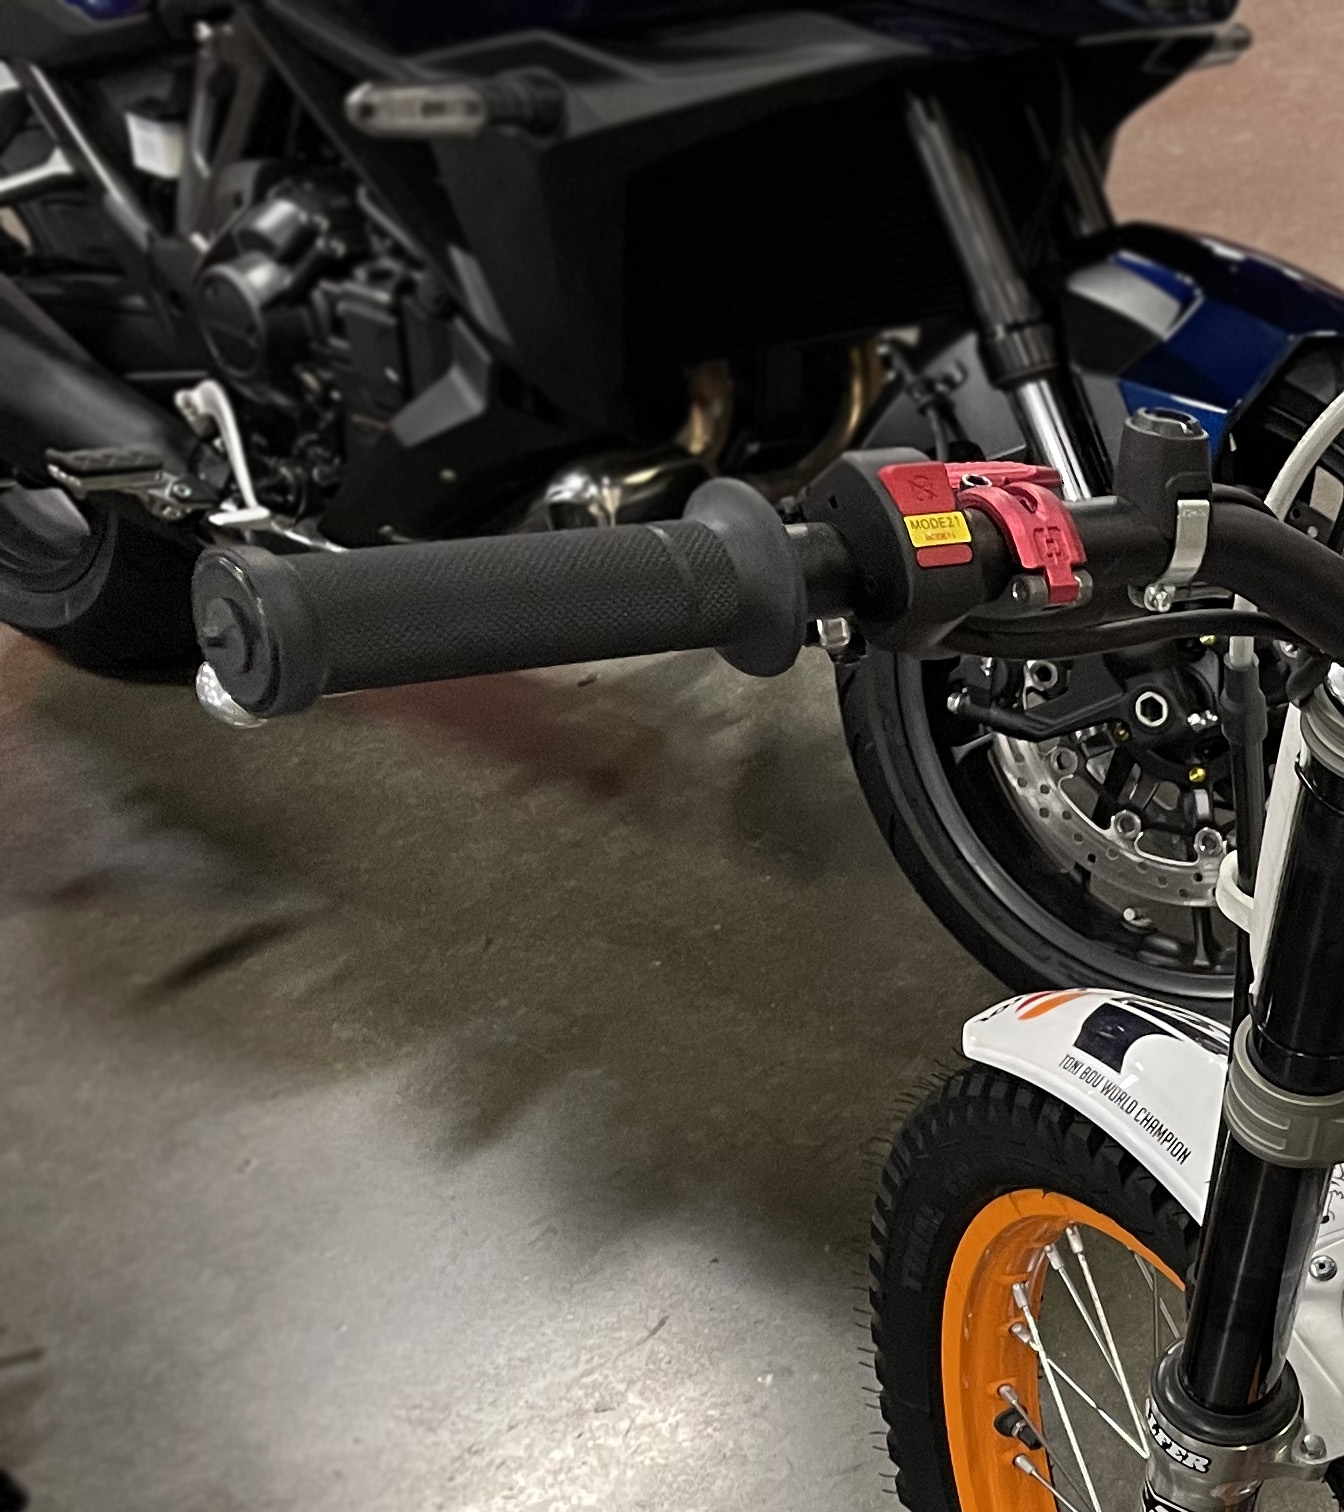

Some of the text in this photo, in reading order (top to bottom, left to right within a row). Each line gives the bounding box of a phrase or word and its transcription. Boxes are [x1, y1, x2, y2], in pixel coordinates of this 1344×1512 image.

[909, 515, 961, 530] MODE21
[1079, 1066, 1103, 1089] BOU
[1099, 1079, 1138, 1115] WORLD
[1133, 1106, 1192, 1165] CHAMPION
